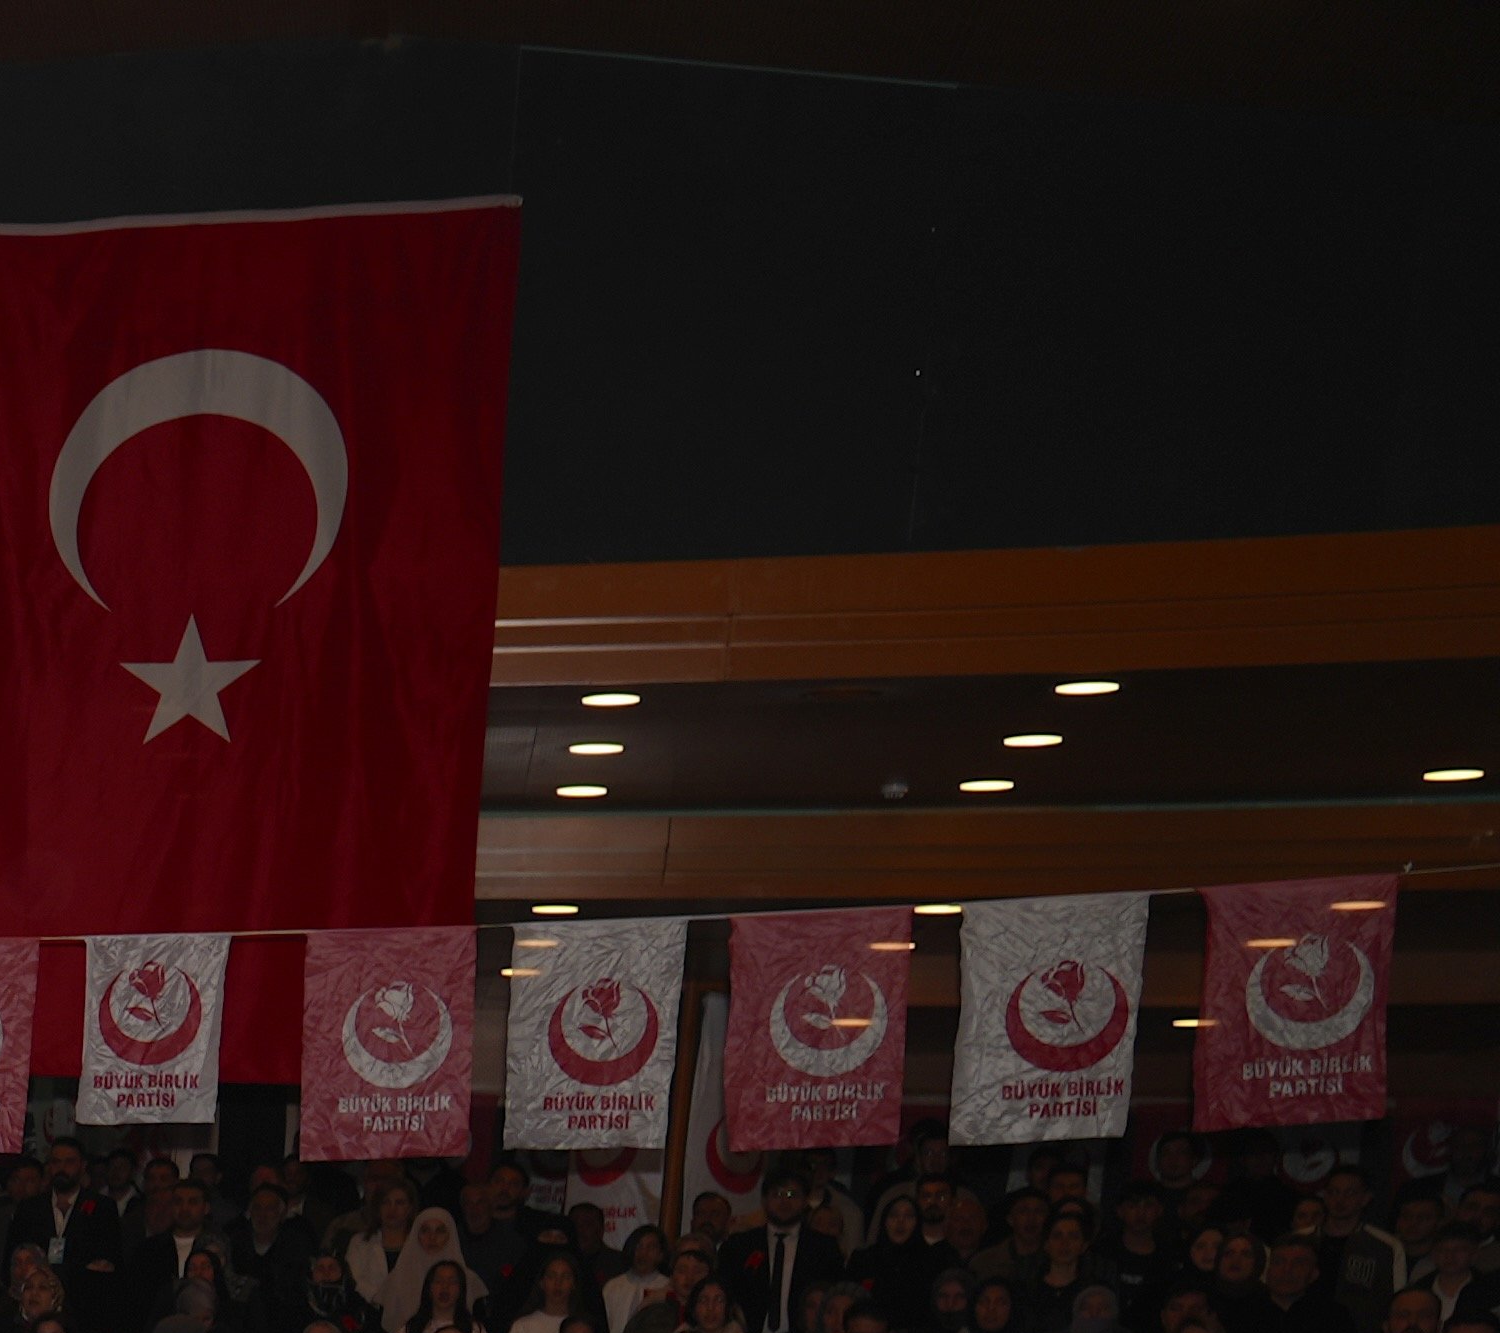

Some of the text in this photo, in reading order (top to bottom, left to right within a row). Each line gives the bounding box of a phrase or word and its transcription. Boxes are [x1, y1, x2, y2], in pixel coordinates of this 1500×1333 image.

[1242, 1059, 1305, 1080] BÜYÜK
[93, 1072, 200, 1090] BÜYÜK BİRLİK
[1002, 1077, 1124, 1100] BÜYÜK BİRLİK
[1268, 1077, 1343, 1098] PARTİSİ
[117, 1090, 176, 1108] PARTİSİ
[543, 1092, 654, 1112] BÜYÜK BİRLİK
[766, 1083, 823, 1104] BÜYÜK
[338, 1095, 391, 1113] BÜYÜK
[791, 1101, 858, 1121] PARTİSİ
[1029, 1098, 1097, 1118] PARTİSİ
[363, 1113, 425, 1132] PARTİSİ
[568, 1112, 630, 1130] PARTİSİ
